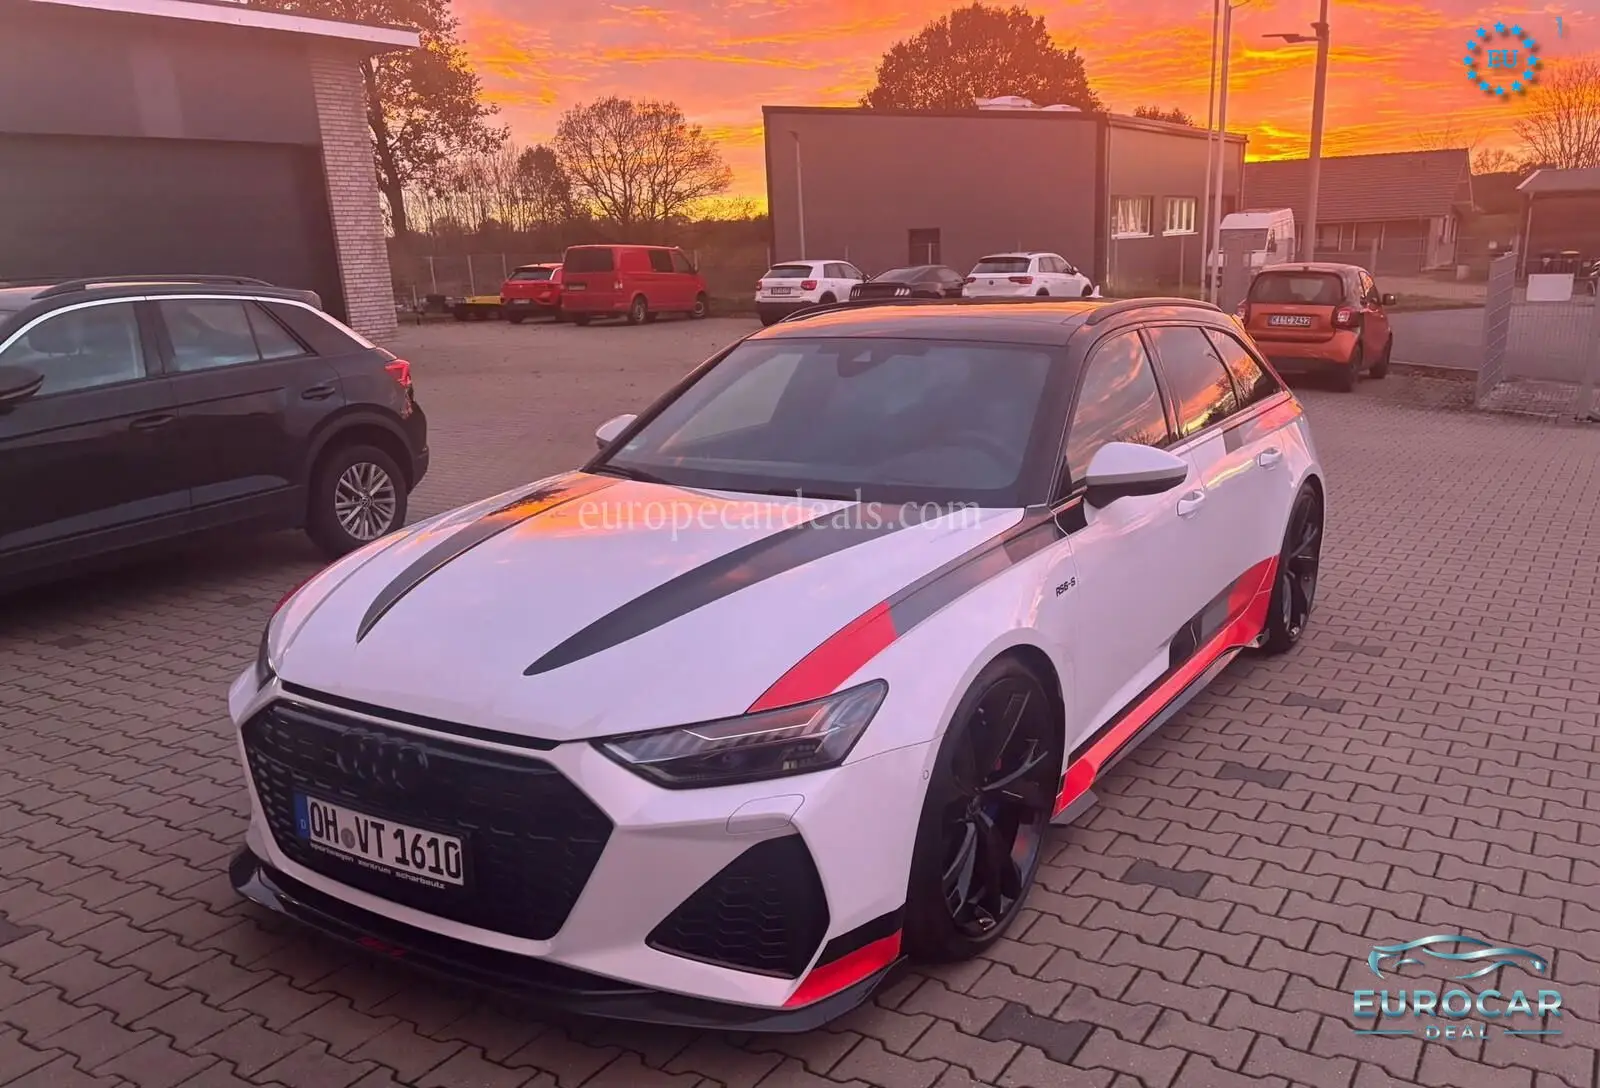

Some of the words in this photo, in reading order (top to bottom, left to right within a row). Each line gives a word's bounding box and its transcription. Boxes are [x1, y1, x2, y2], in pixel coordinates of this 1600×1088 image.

[310, 801, 340, 844] OH
[354, 815, 385, 859] VT
[393, 828, 461, 880] 1610
[357, 859, 392, 876] zentrum
